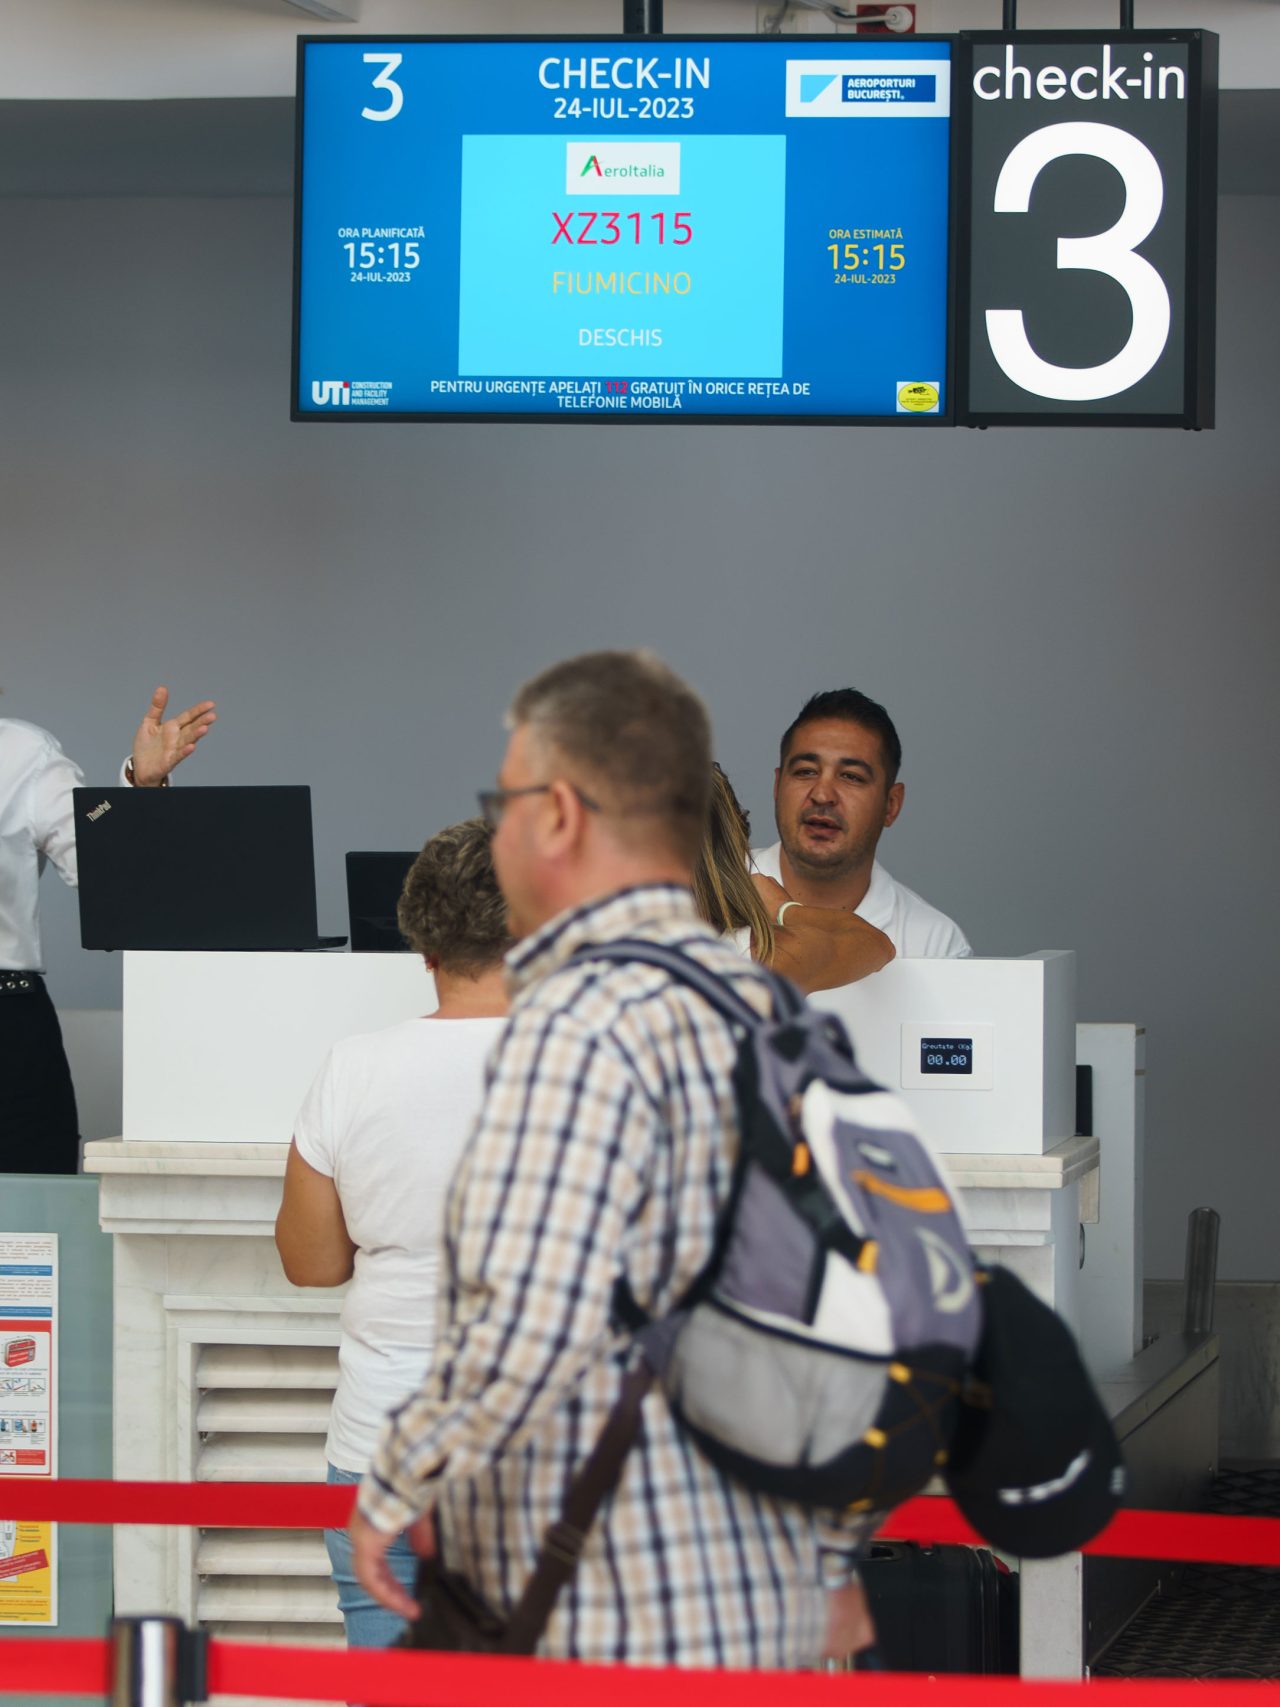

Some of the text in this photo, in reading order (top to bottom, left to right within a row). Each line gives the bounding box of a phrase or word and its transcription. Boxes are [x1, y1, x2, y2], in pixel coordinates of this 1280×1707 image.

[538, 57, 711, 90] CHECK-IN
[847, 78, 916, 88] AEROPORTURI
[973, 44, 1185, 100] check-in
[361, 53, 404, 122] 3
[554, 97, 694, 119] 24-IUL-2023
[580, 155, 665, 178] AeroItalia
[338, 226, 425, 238] ORA PLANIFICATĂ
[551, 212, 693, 245] XZ3115
[829, 227, 903, 239] ORA ESTIMATĂ
[343, 242, 420, 269] 15:15
[827, 244, 906, 270] 15:15
[985, 121, 1171, 401] 3
[350, 272, 411, 282] 24-IUL-2023
[552, 271, 691, 295] FIUMICINO
[834, 273, 896, 284] 24-IUL-2023
[578, 328, 662, 347] DESCHIS
[431, 380, 482, 393] PENTRU
[605, 381, 628, 393] 112
[630, 381, 685, 394] GRATUIT
[688, 379, 702, 394] ÎN
[705, 382, 744, 395] ORICE
[793, 383, 811, 395] DE
[557, 395, 682, 408] TELEFONIE MOBILĂ
[927, 1055, 967, 1065] 00.00
